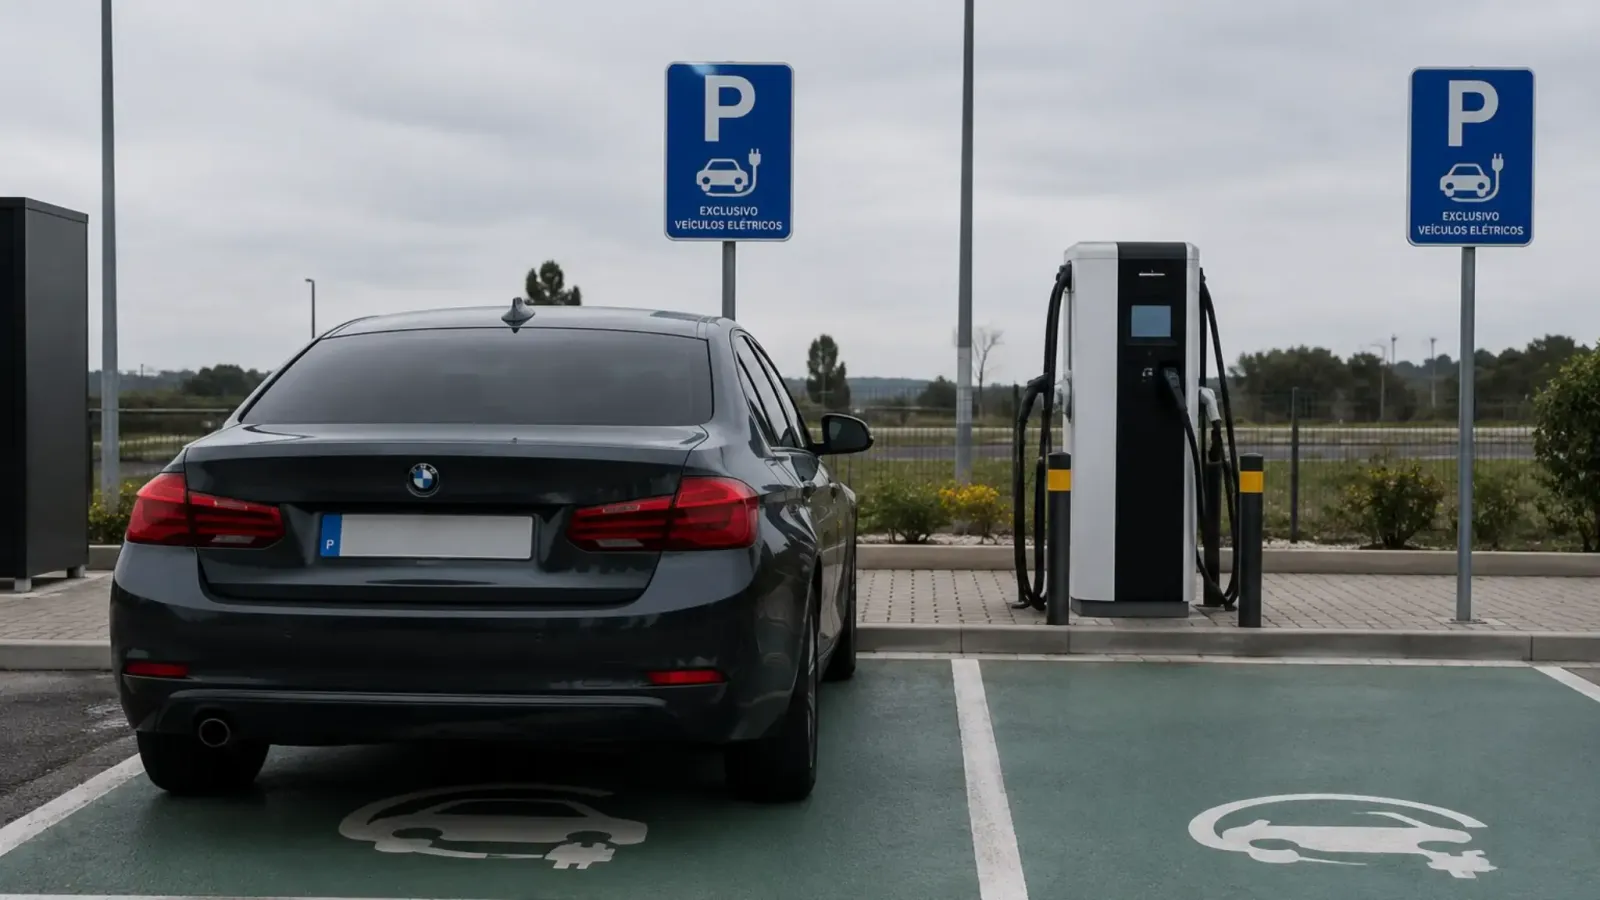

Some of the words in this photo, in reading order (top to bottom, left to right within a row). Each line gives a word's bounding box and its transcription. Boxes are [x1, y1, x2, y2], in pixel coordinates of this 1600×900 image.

[705, 75, 755, 142] P
[1449, 80, 1498, 147] P
[699, 206, 758, 216] EXCLUSIVO
[1442, 211, 1499, 221] EXCLUSIVO
[675, 218, 724, 229] VEÍCULOS
[727, 218, 782, 230] ELÉTRICOS
[1418, 224, 1467, 235] VEÍCULOS
[1470, 224, 1524, 235] ELÉTRICOS
[326, 539, 334, 549] P
